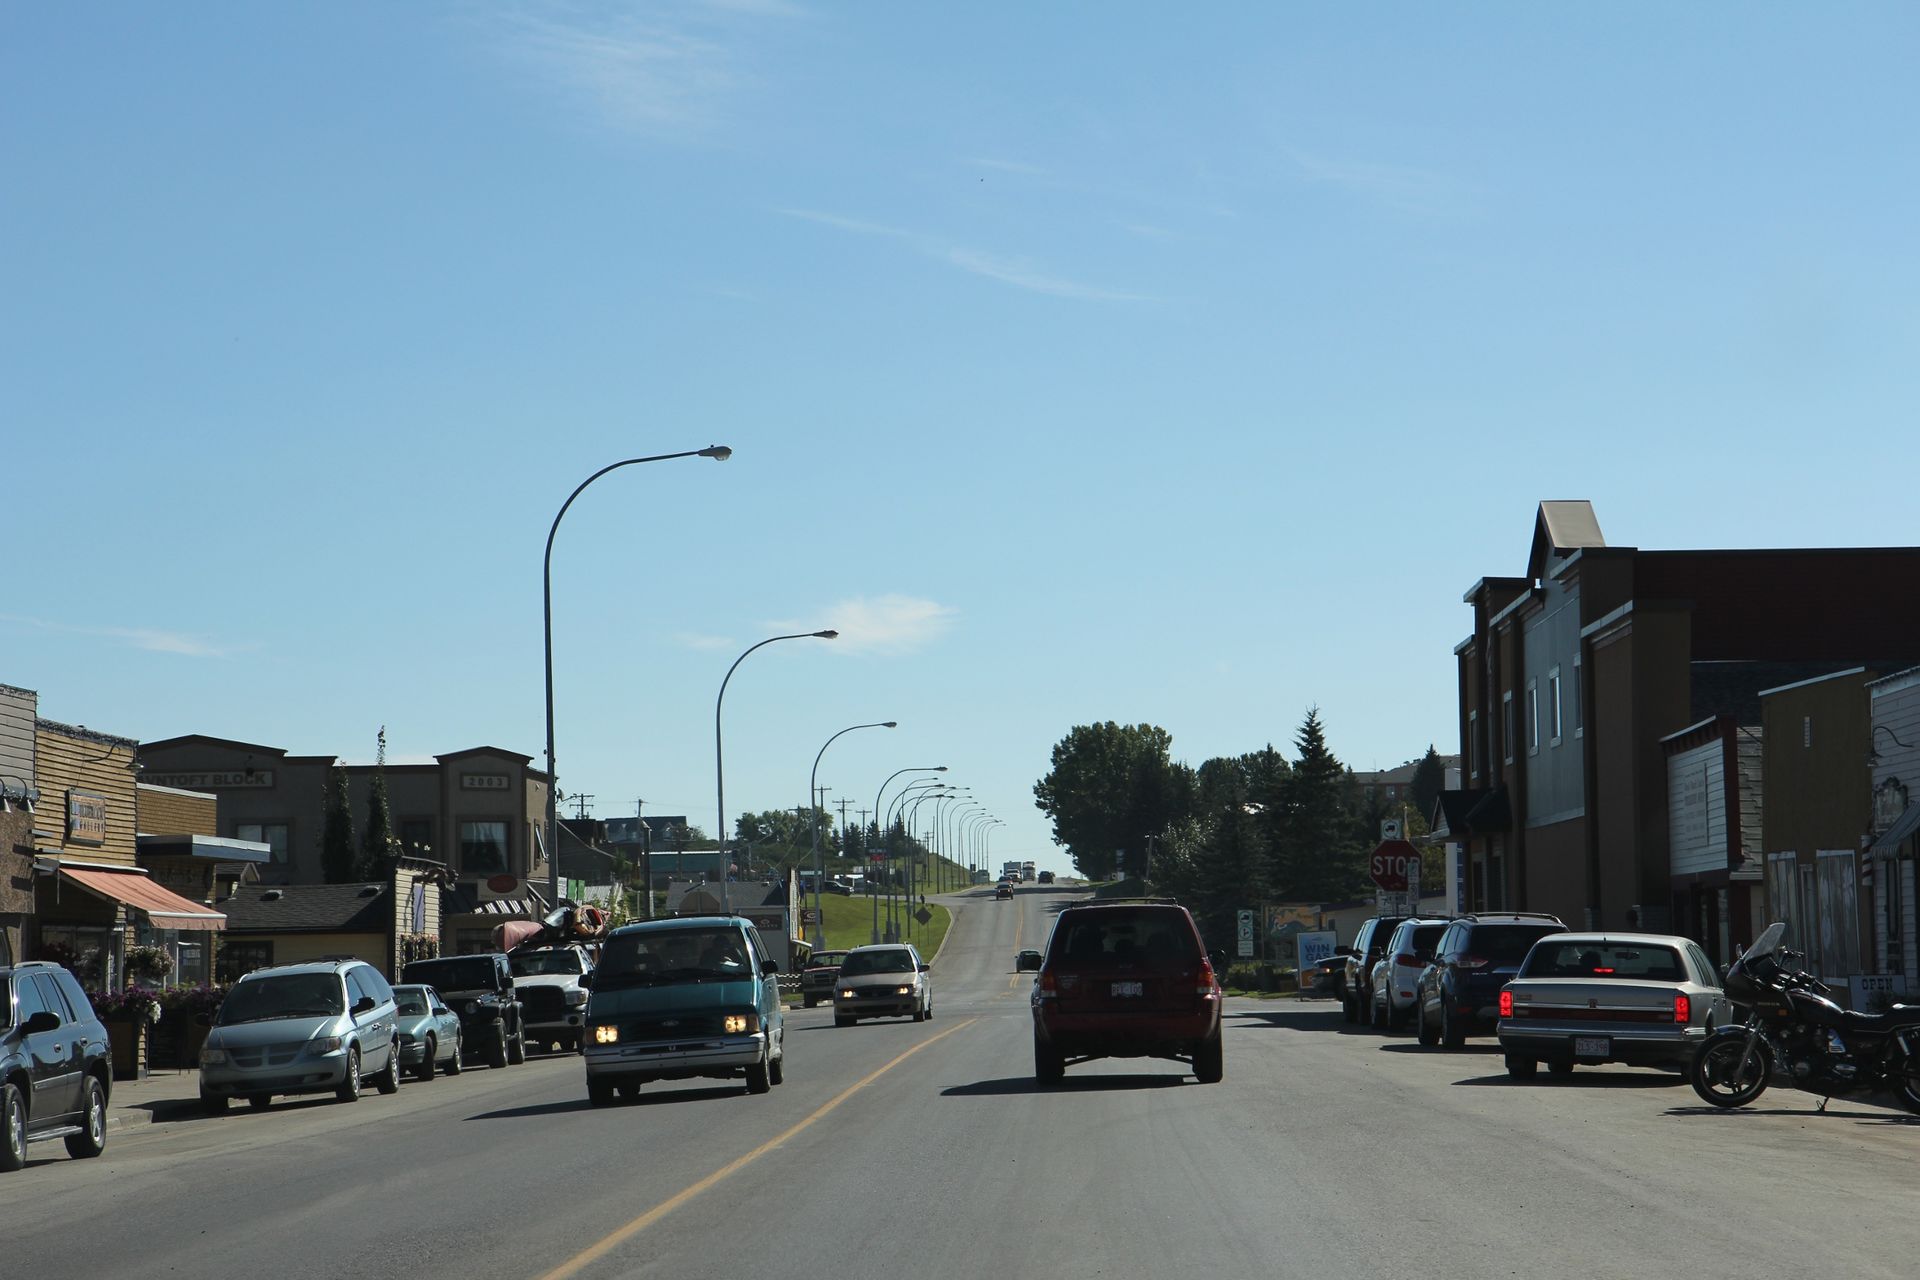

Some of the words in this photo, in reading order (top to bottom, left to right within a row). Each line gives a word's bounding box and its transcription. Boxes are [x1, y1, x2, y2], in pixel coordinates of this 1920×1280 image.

[213, 774, 266, 785] BLOCK
[1305, 943, 1330, 953] WIN
[1861, 977, 1893, 990] OPEN
